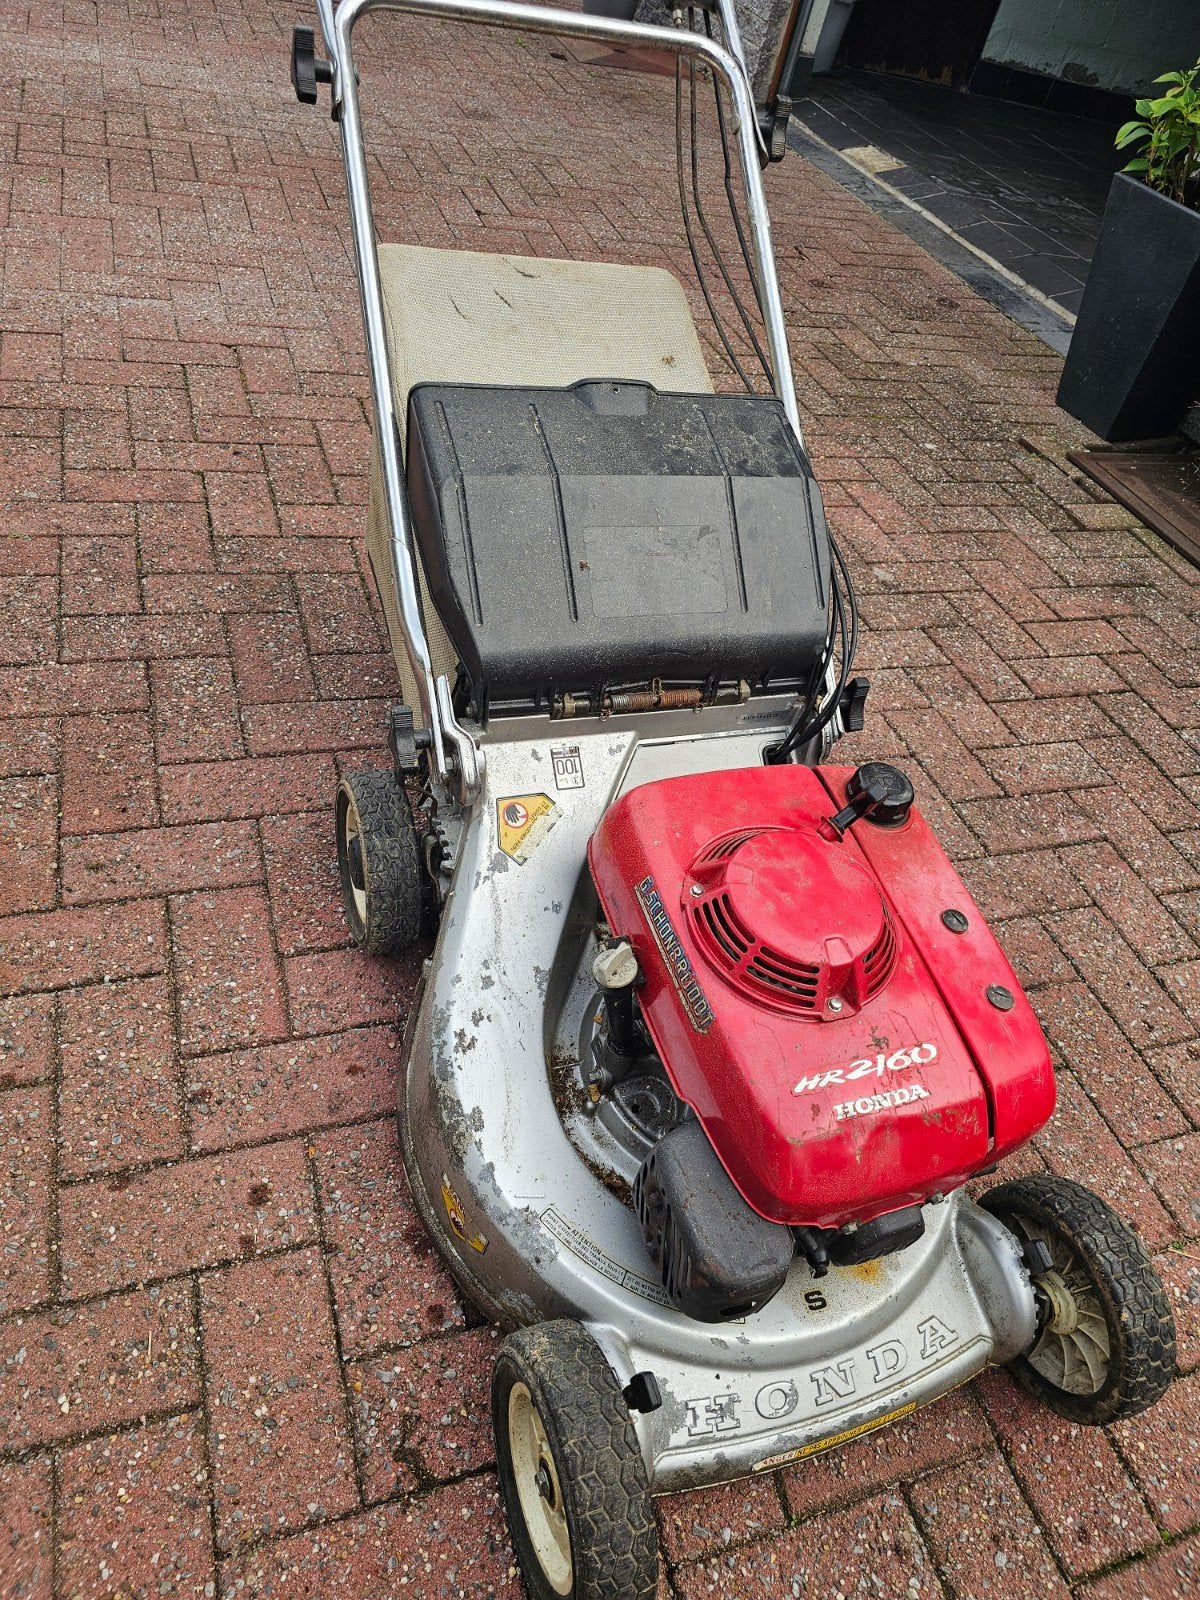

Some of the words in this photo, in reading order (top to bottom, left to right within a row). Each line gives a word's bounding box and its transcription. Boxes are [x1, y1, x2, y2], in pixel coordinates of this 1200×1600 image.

[556, 759, 579, 775] 100
[833, 1083, 930, 1120] HONDA
[571, 1229, 601, 1255] ATTENTION
[804, 1290, 827, 1310] S
[685, 1315, 959, 1436] HONDA
[760, 1453, 792, 1466] ANGER
